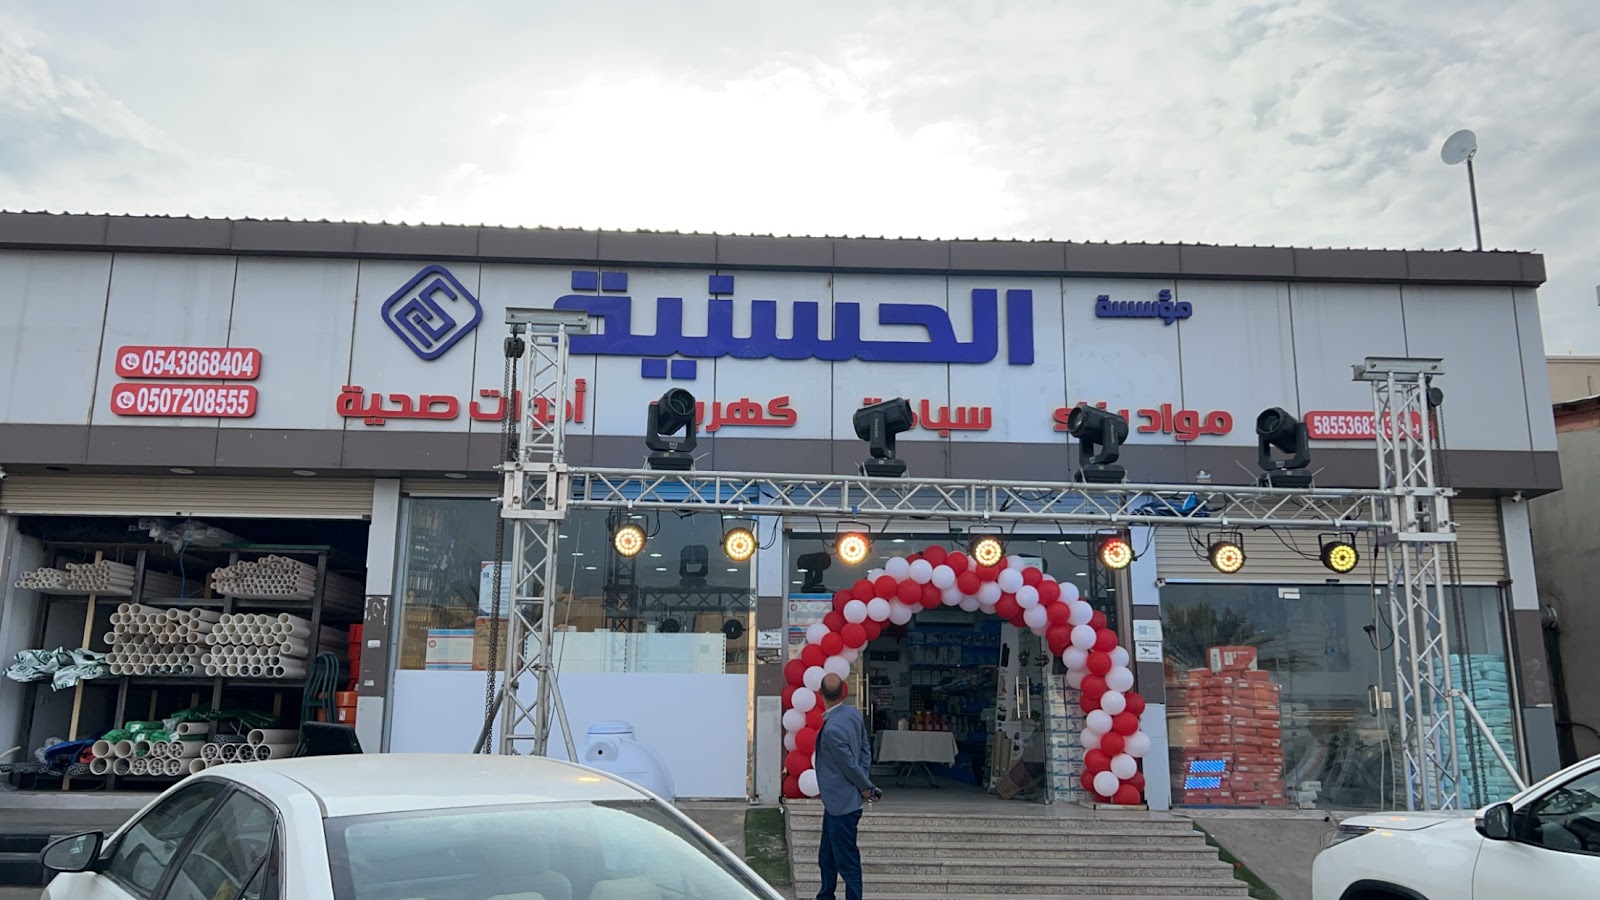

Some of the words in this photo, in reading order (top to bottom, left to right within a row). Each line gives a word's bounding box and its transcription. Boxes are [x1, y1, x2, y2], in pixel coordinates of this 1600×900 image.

[552, 271, 1034, 380] الحسنية
[1095, 289, 1192, 326] مؤسسة
[142, 349, 254, 376] 0543868404
[136, 387, 249, 414] 0507208555
[336, 384, 460, 426] صحية
[1137, 403, 1233, 441] مواد
